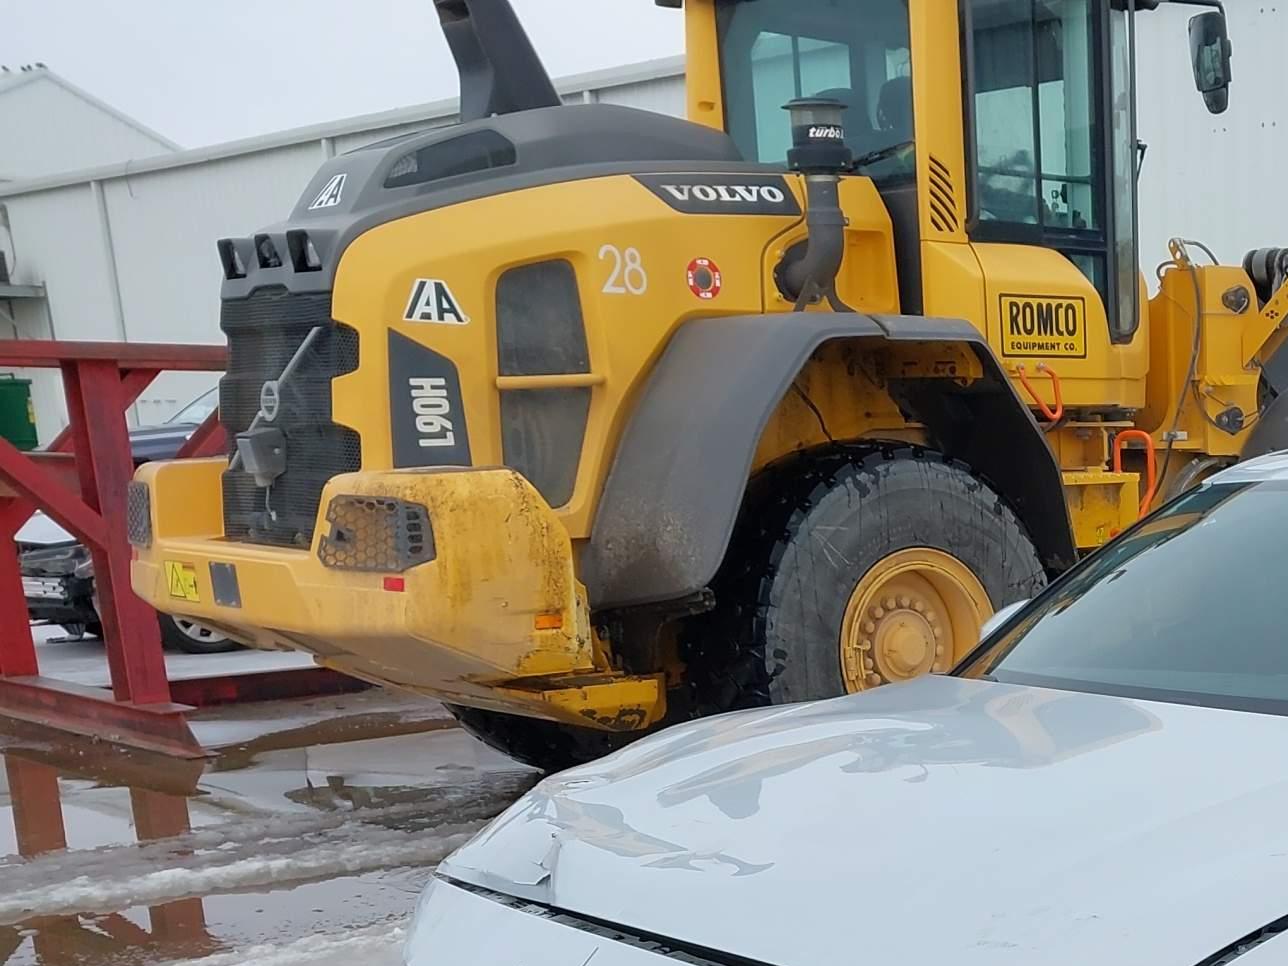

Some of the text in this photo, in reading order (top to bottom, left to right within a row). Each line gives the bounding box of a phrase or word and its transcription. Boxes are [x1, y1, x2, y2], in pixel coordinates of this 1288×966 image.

[660, 184, 785, 203] VOLVO
[598, 244, 648, 295] 28
[1009, 301, 1077, 337] ROMCO
[1010, 341, 1077, 352] EQUIPMENT CO.
[409, 377, 456, 447] L90H
